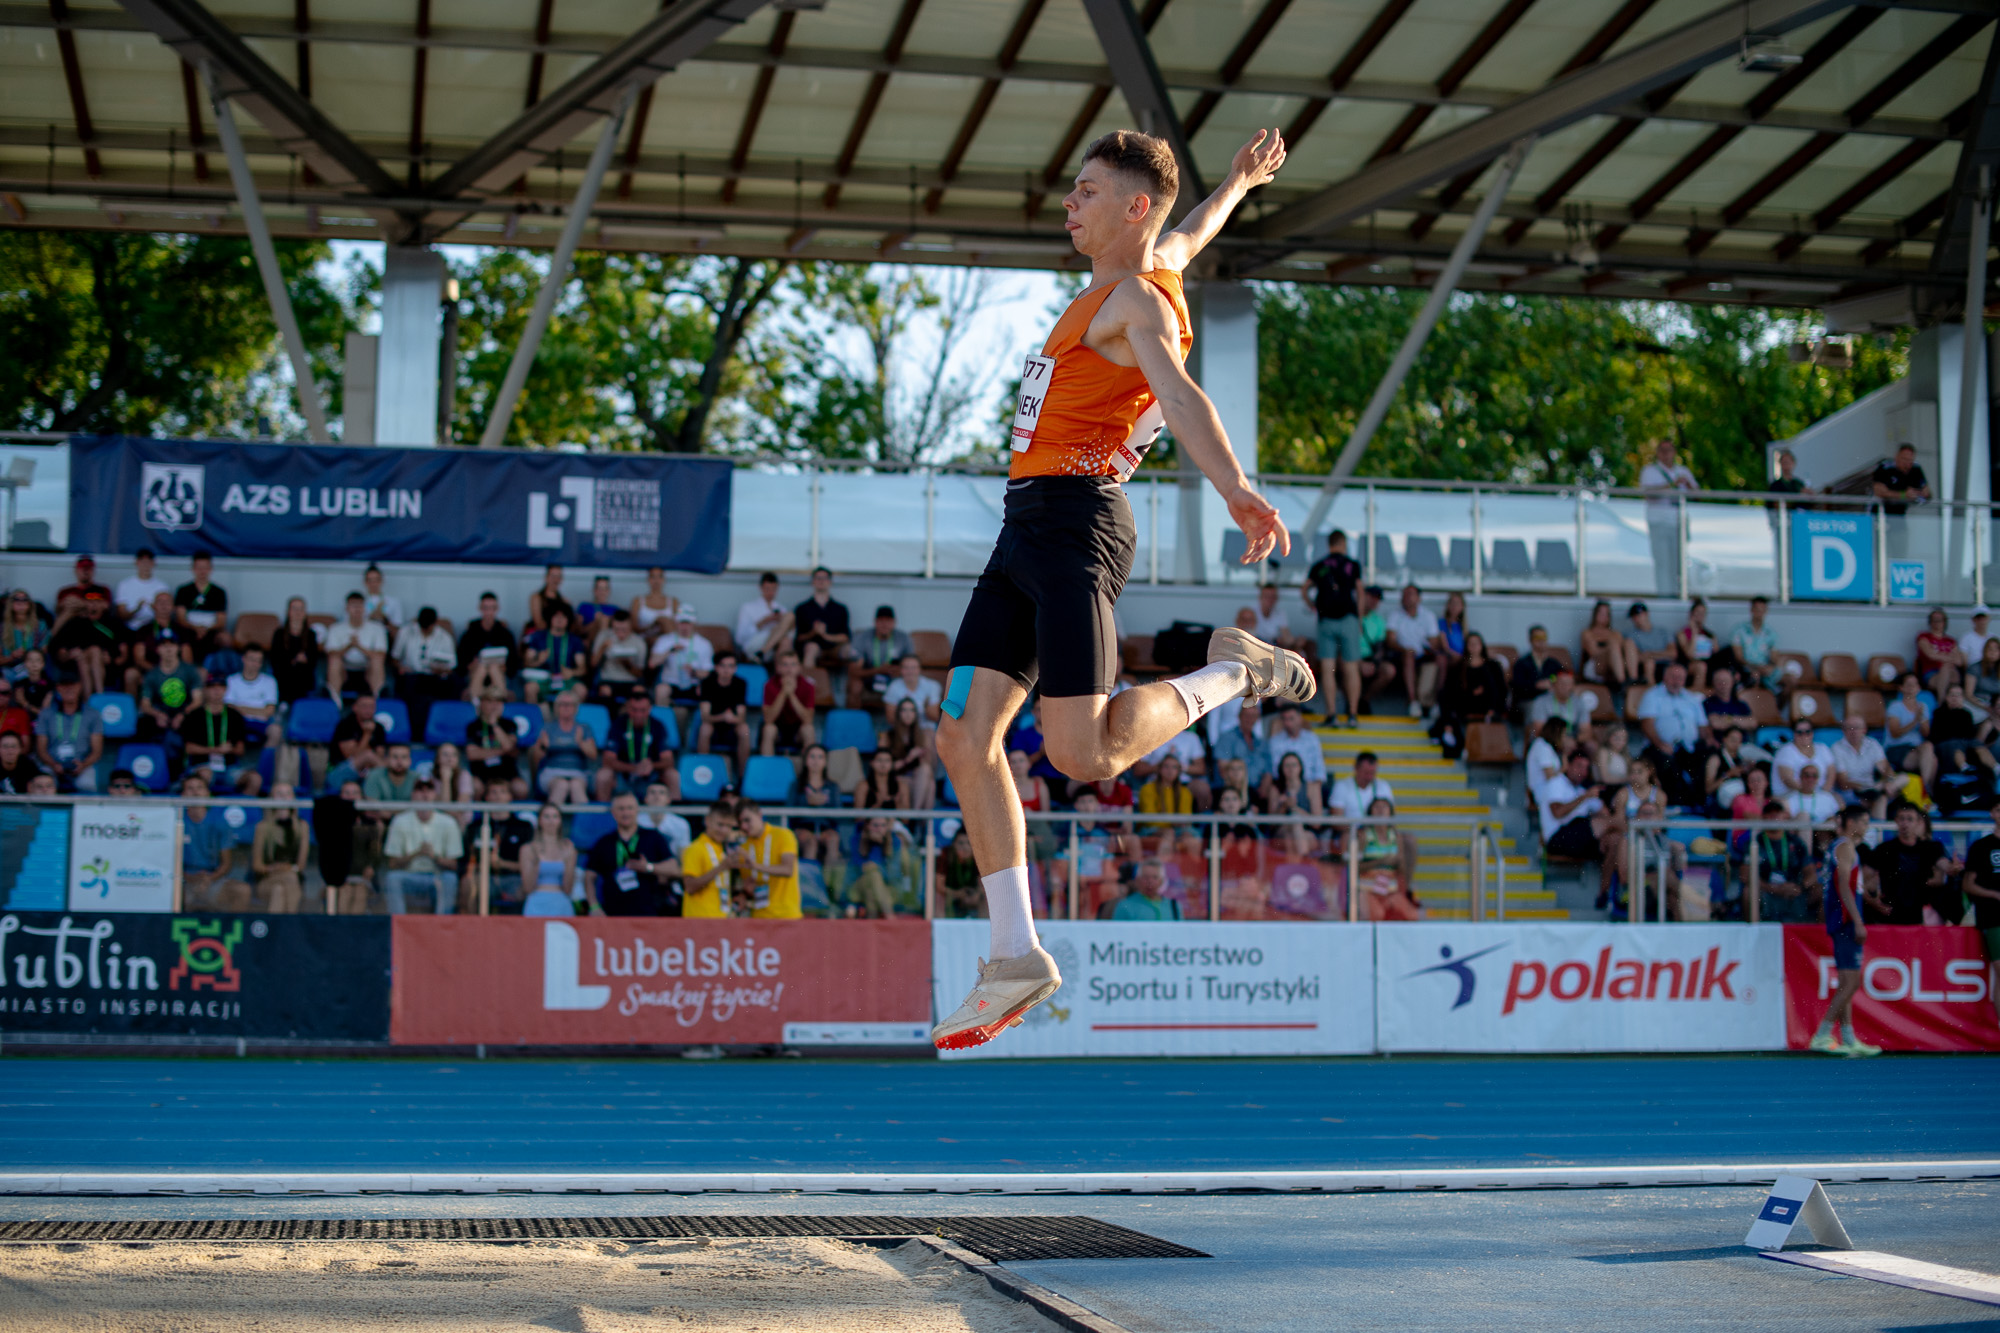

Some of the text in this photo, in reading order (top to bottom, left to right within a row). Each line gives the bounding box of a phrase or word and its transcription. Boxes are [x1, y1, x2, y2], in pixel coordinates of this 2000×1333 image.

[221, 483, 422, 518] AZS LUBLIN
[1811, 536, 1857, 591] D
[1892, 566, 1924, 586] WC
[1090, 942, 1264, 966] Ministerstwo
[1089, 975, 1320, 1003] Sportu i Turystyki
[1501, 944, 1741, 1017] polanik
[1818, 956, 1995, 1003] POLS
[101, 999, 241, 1019] INSPIRACJI
[618, 981, 785, 1027] Smakuj życie!
